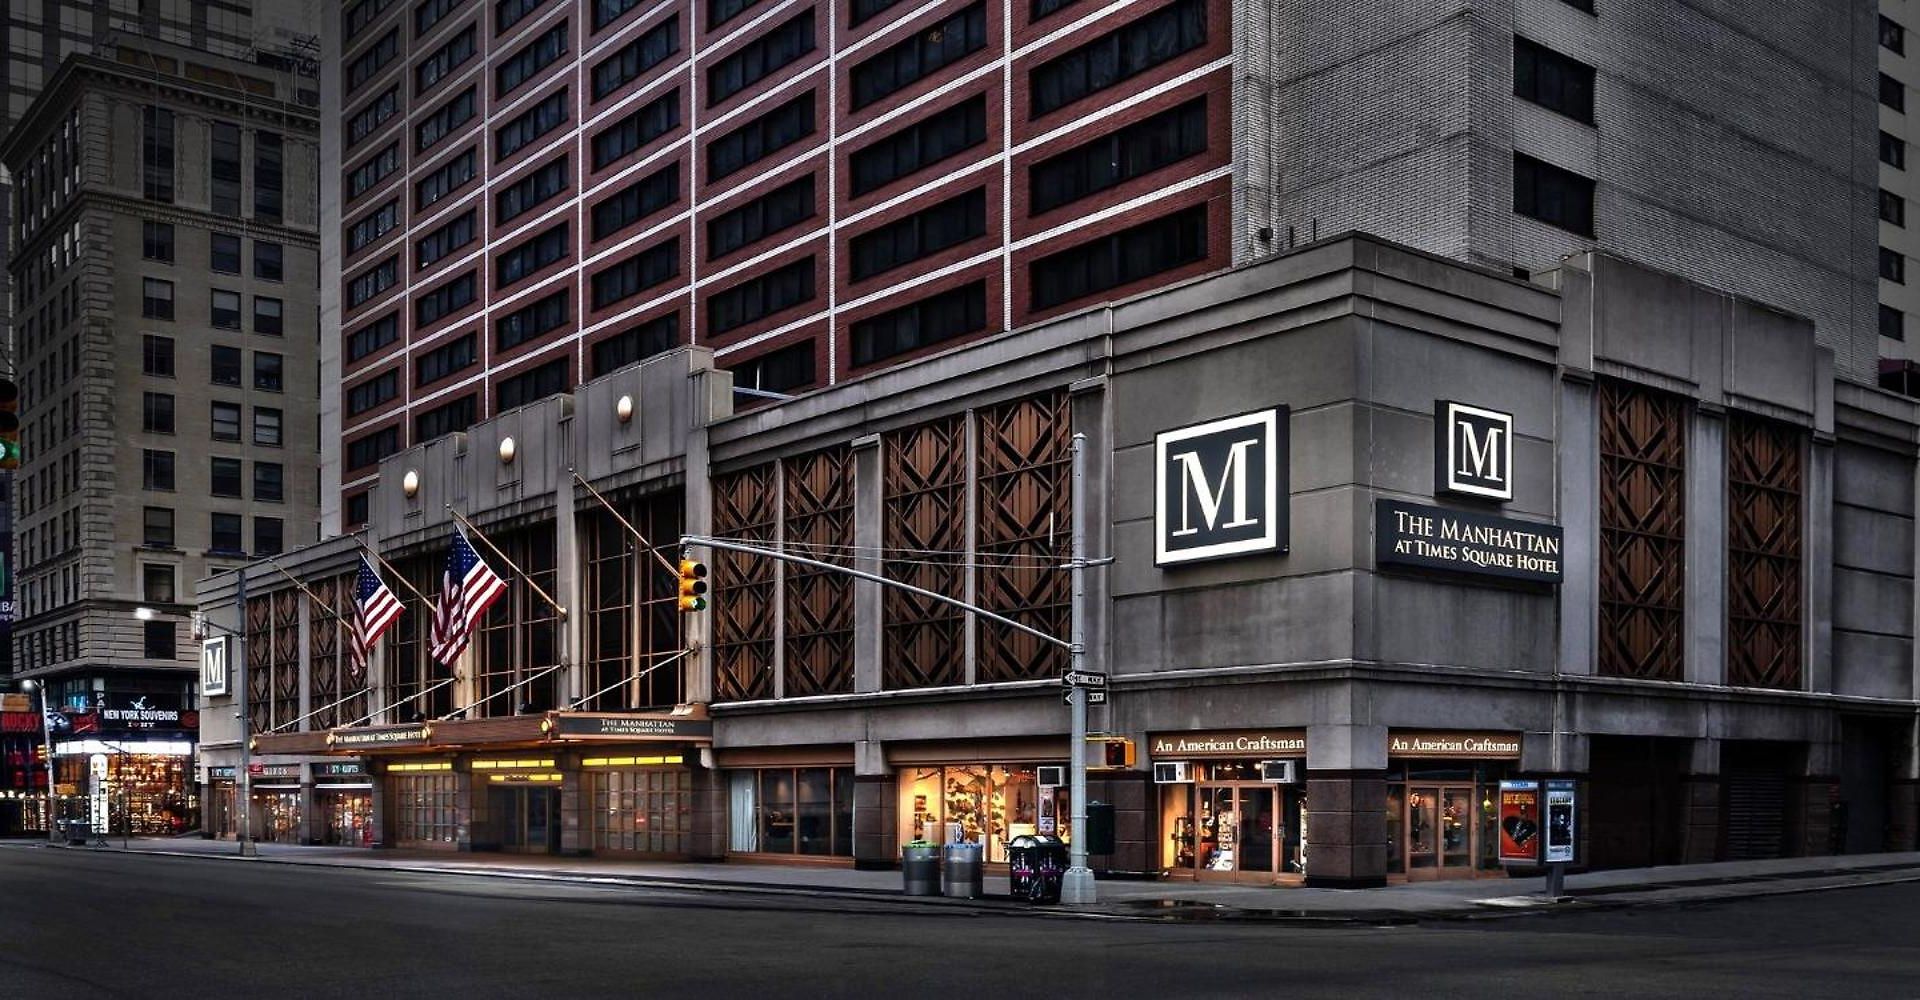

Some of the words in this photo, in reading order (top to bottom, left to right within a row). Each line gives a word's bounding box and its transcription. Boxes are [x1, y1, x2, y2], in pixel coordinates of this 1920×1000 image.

[1457, 421, 1504, 482] M
[1172, 438, 1259, 538] M
[1394, 510, 1434, 537] THE
[1440, 518, 1560, 555] MANHATTAN
[1395, 539, 1412, 554] AT
[1414, 540, 1457, 561] TIMES
[1462, 546, 1513, 568] SQUARE
[1517, 554, 1560, 574] HOTEL
[206, 647, 222, 685] M
[104, 710, 119, 720] NEW
[121, 710, 139, 720] YORK
[140, 710, 179, 721] SOUVENIRS
[620, 719, 675, 728] MANHATTAN
[1155, 739, 1173, 752] An
[1177, 738, 1234, 751] American
[1236, 736, 1305, 750] Craftsman
[1392, 738, 1408, 750] An
[1412, 738, 1462, 751] American
[1464, 738, 1519, 752] Craftsman
